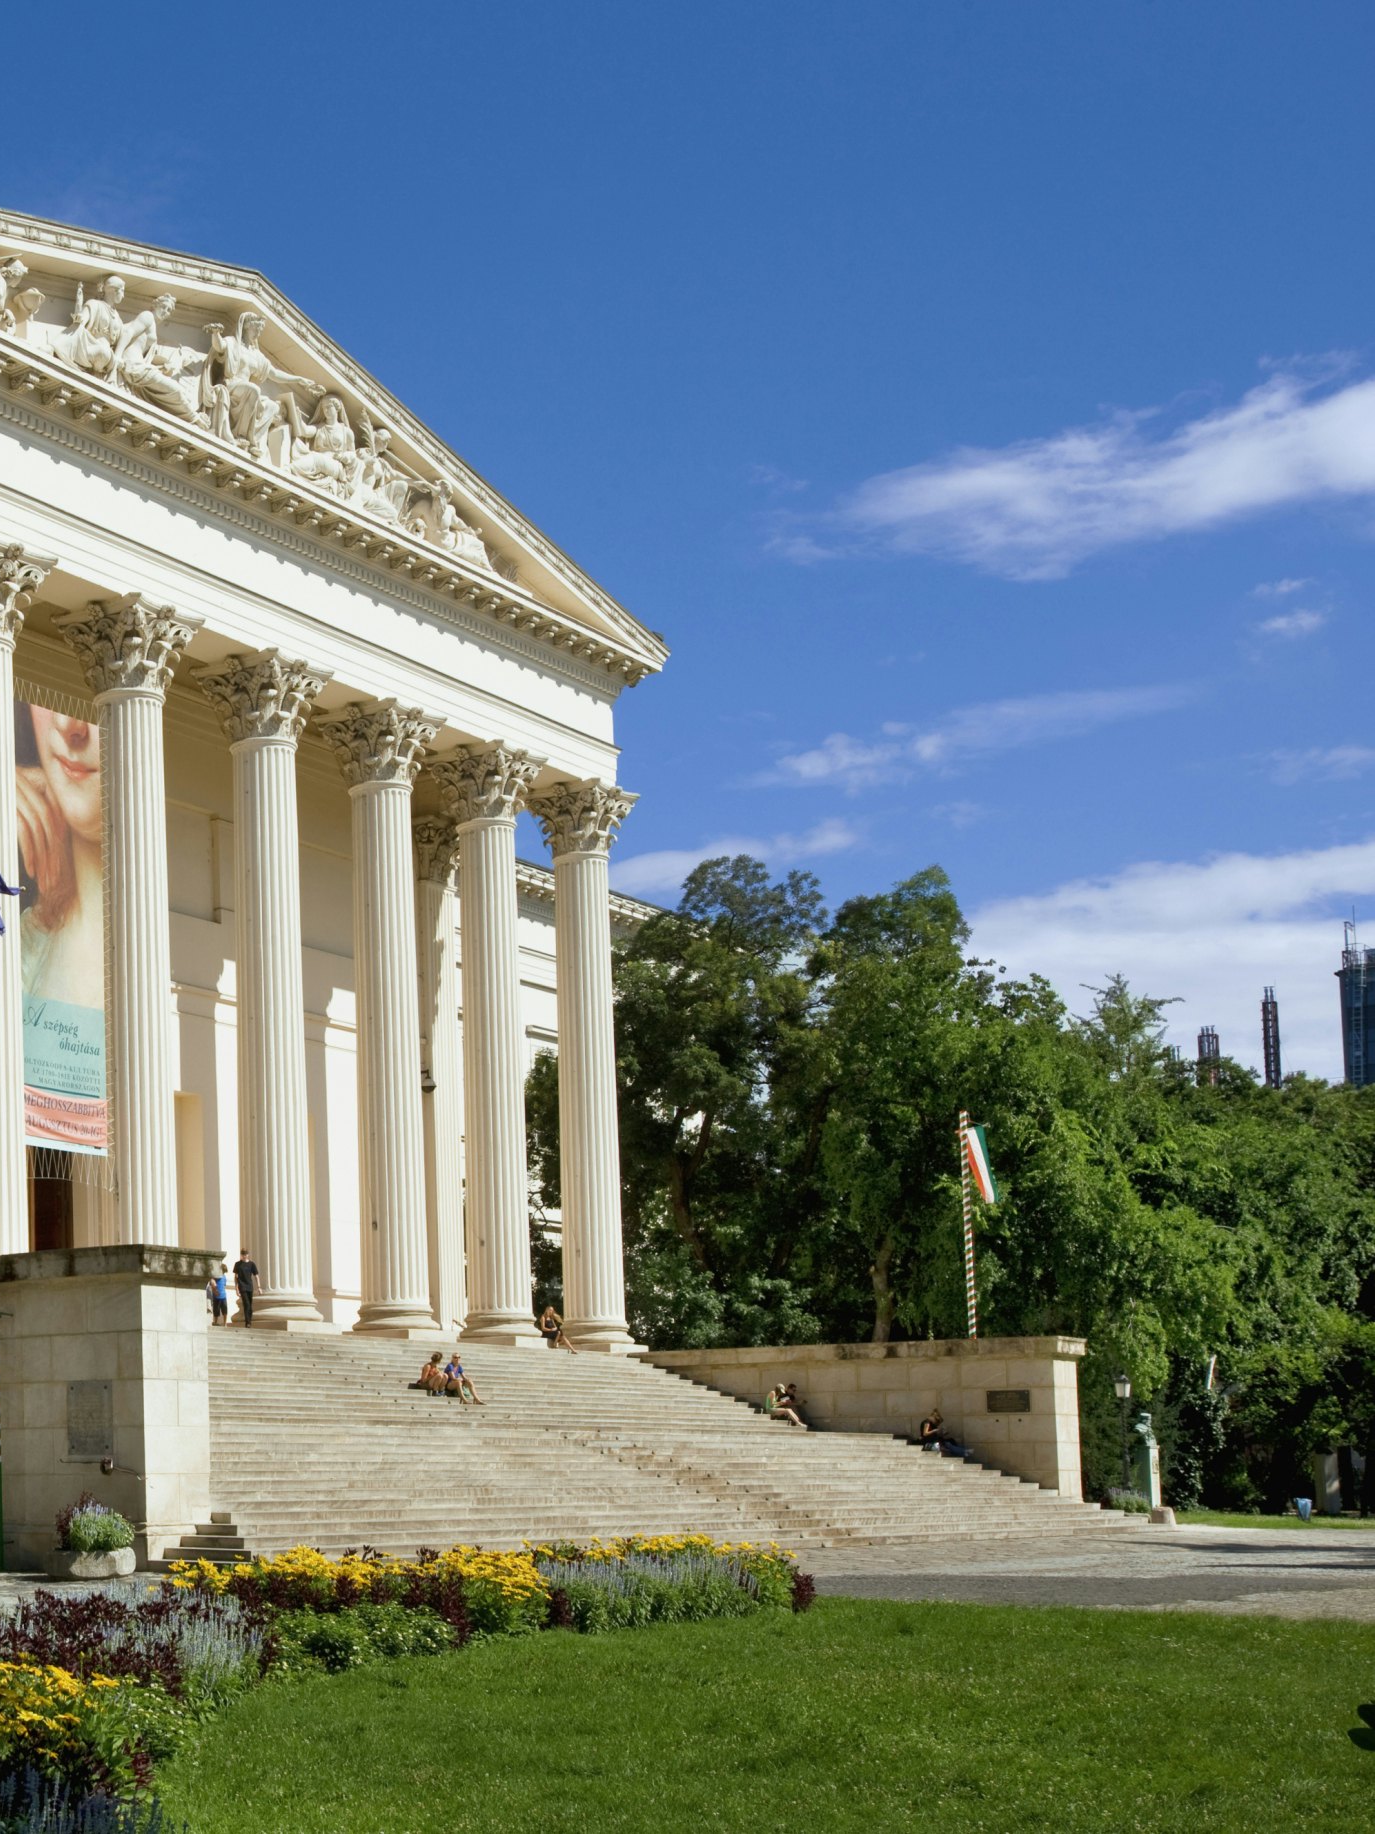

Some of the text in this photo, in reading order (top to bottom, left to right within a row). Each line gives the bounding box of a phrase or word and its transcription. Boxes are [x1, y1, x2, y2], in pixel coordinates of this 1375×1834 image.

[23, 1002, 79, 1038] A szépség
[59, 1037, 100, 1056] óhajtása
[25, 1114, 79, 1134] AUGUSZTUS
